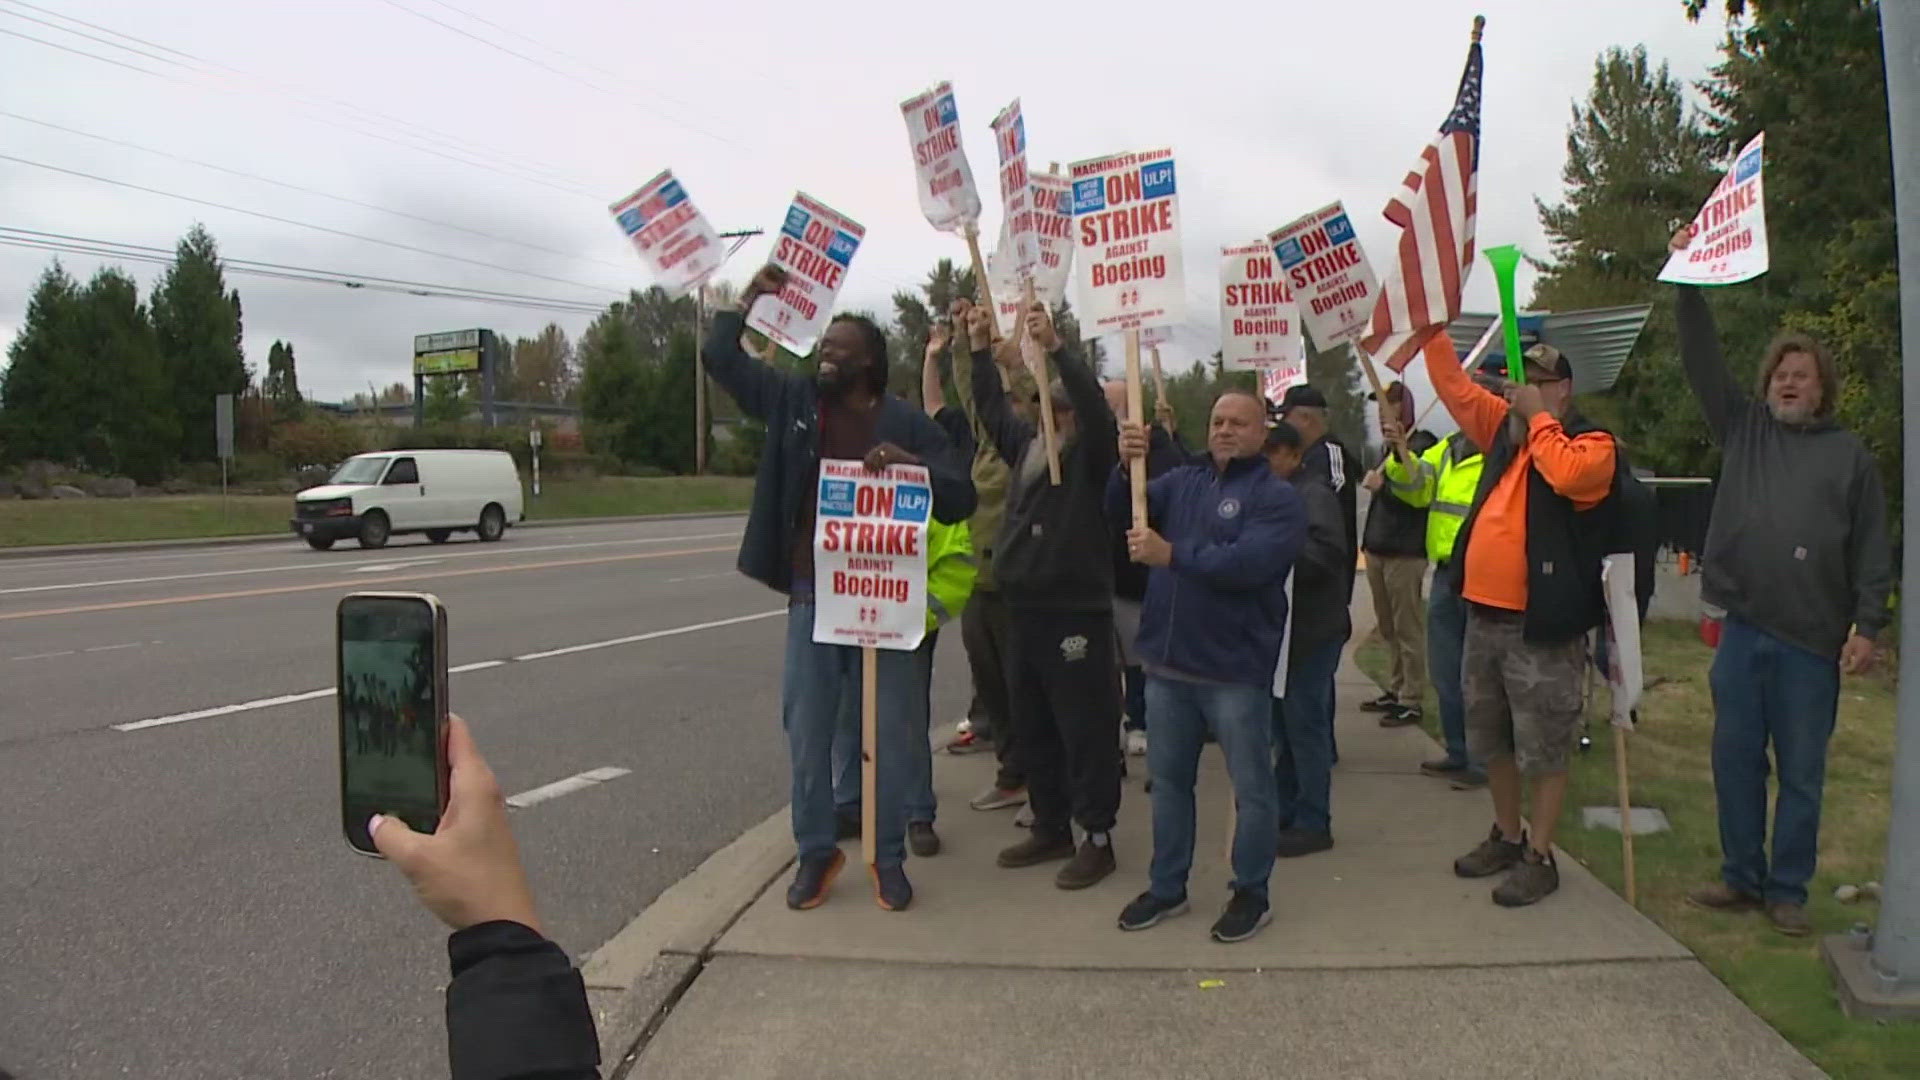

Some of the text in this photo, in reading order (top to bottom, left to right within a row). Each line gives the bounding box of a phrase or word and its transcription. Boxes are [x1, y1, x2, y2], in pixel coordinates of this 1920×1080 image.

[917, 125, 958, 166] STRIKE
[1073, 148, 1172, 178] MACHINISTS UNION
[1106, 168, 1172, 206] ON ULP!
[805, 220, 836, 251] ON
[1080, 199, 1173, 247] STRIKE
[1105, 240, 1150, 260] AGAINST
[1300, 227, 1330, 256] ON
[1689, 228, 1753, 263] Boeing
[776, 236, 843, 290] STRIKE
[1091, 254, 1166, 288] Boeing
[1246, 256, 1273, 280] ON
[1290, 242, 1361, 289] STRIKE
[1244, 306, 1278, 317] AGAINST
[1310, 280, 1368, 316] Boeing
[1233, 318, 1289, 336] Boeing
[856, 485, 927, 518] ON ULP!
[823, 520, 920, 556] STRIKE
[848, 557, 894, 572] AGAINST
[833, 571, 909, 603] Boeing
